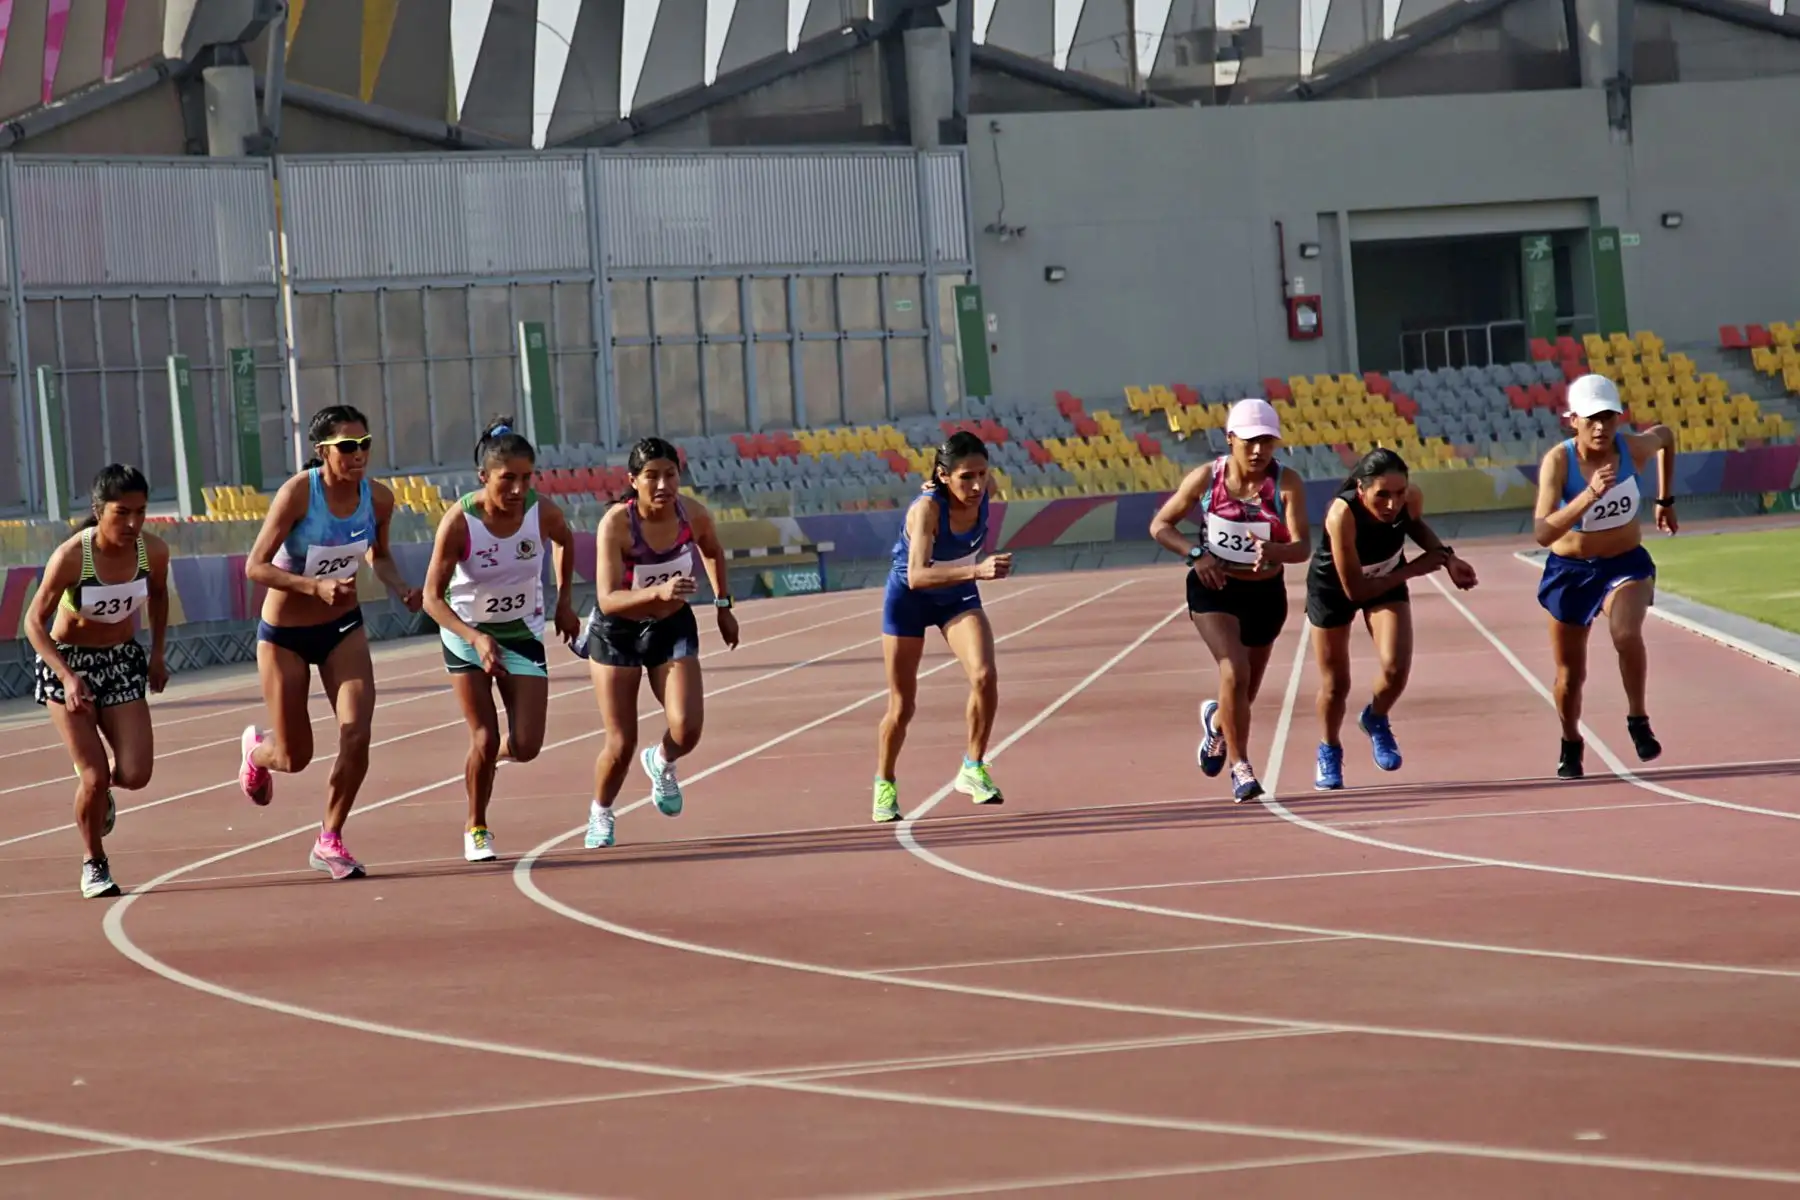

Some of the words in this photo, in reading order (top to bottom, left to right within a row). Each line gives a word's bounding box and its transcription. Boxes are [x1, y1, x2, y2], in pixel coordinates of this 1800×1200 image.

[1594, 495, 1631, 520] 229
[1217, 531, 1256, 552] 232
[92, 596, 132, 615] 231
[485, 593, 525, 613] 233
